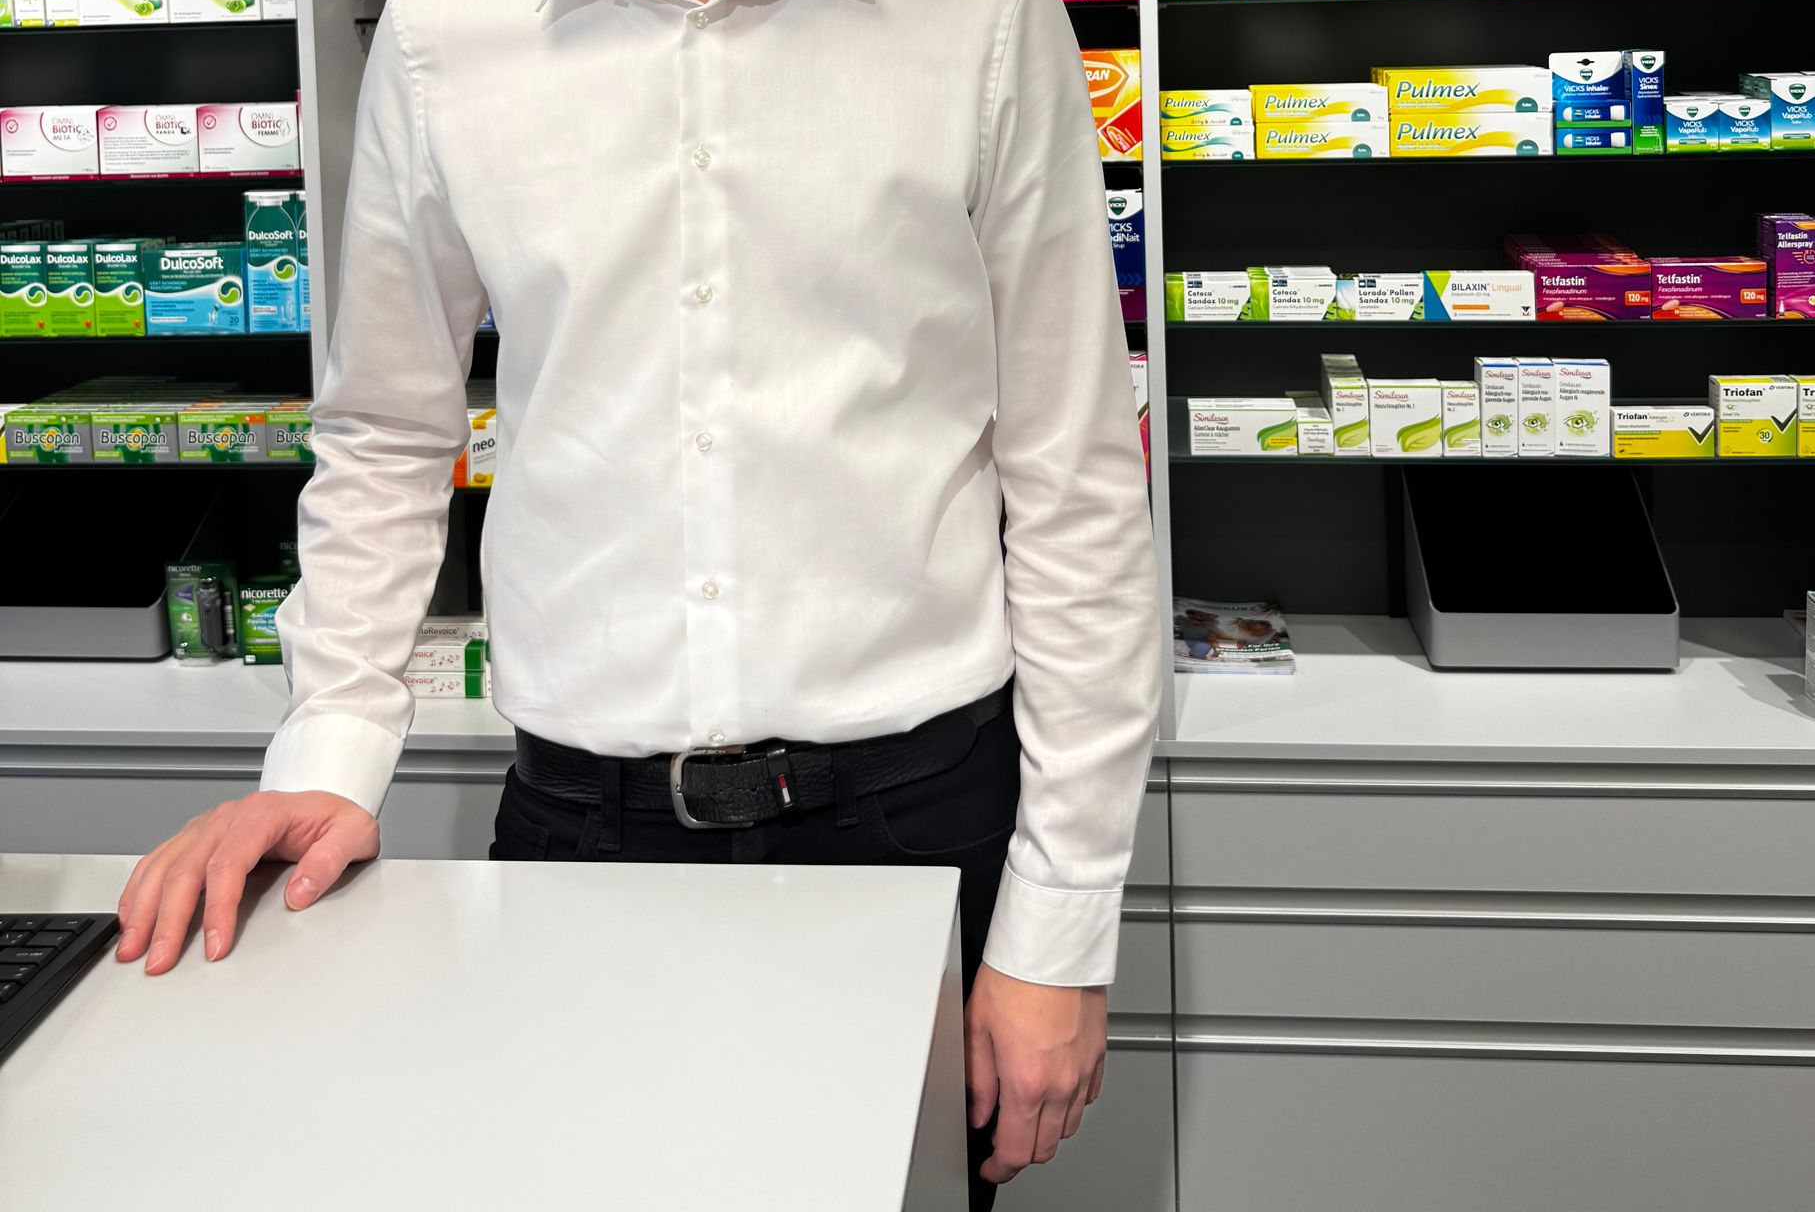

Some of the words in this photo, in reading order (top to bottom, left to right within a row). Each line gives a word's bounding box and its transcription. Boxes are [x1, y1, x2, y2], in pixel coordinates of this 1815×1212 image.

[1396, 80, 1480, 99] Pulmex
[1586, 84, 1609, 92] Inhaler
[1265, 94, 1330, 109] Pulmex
[1782, 112, 1813, 120] VapoRub
[1266, 129, 1330, 144] Pulmex
[1396, 121, 1481, 140] Pulmex
[1777, 241, 1814, 249] Allerspray
[0, 254, 42, 264] DulcoLax
[160, 256, 224, 270] DulcoSoft
[1540, 275, 1585, 286] Telfastin
[1451, 283, 1488, 291] BILAXIN
[1491, 282, 1522, 292] Lingual
[1627, 294, 1640, 302] 120
[1484, 369, 1515, 380] Similasan
[15, 429, 81, 449] Buscopan
[101, 429, 167, 449] Buscopan
[187, 429, 256, 448] Buscopan
[240, 587, 288, 599] nicorette
